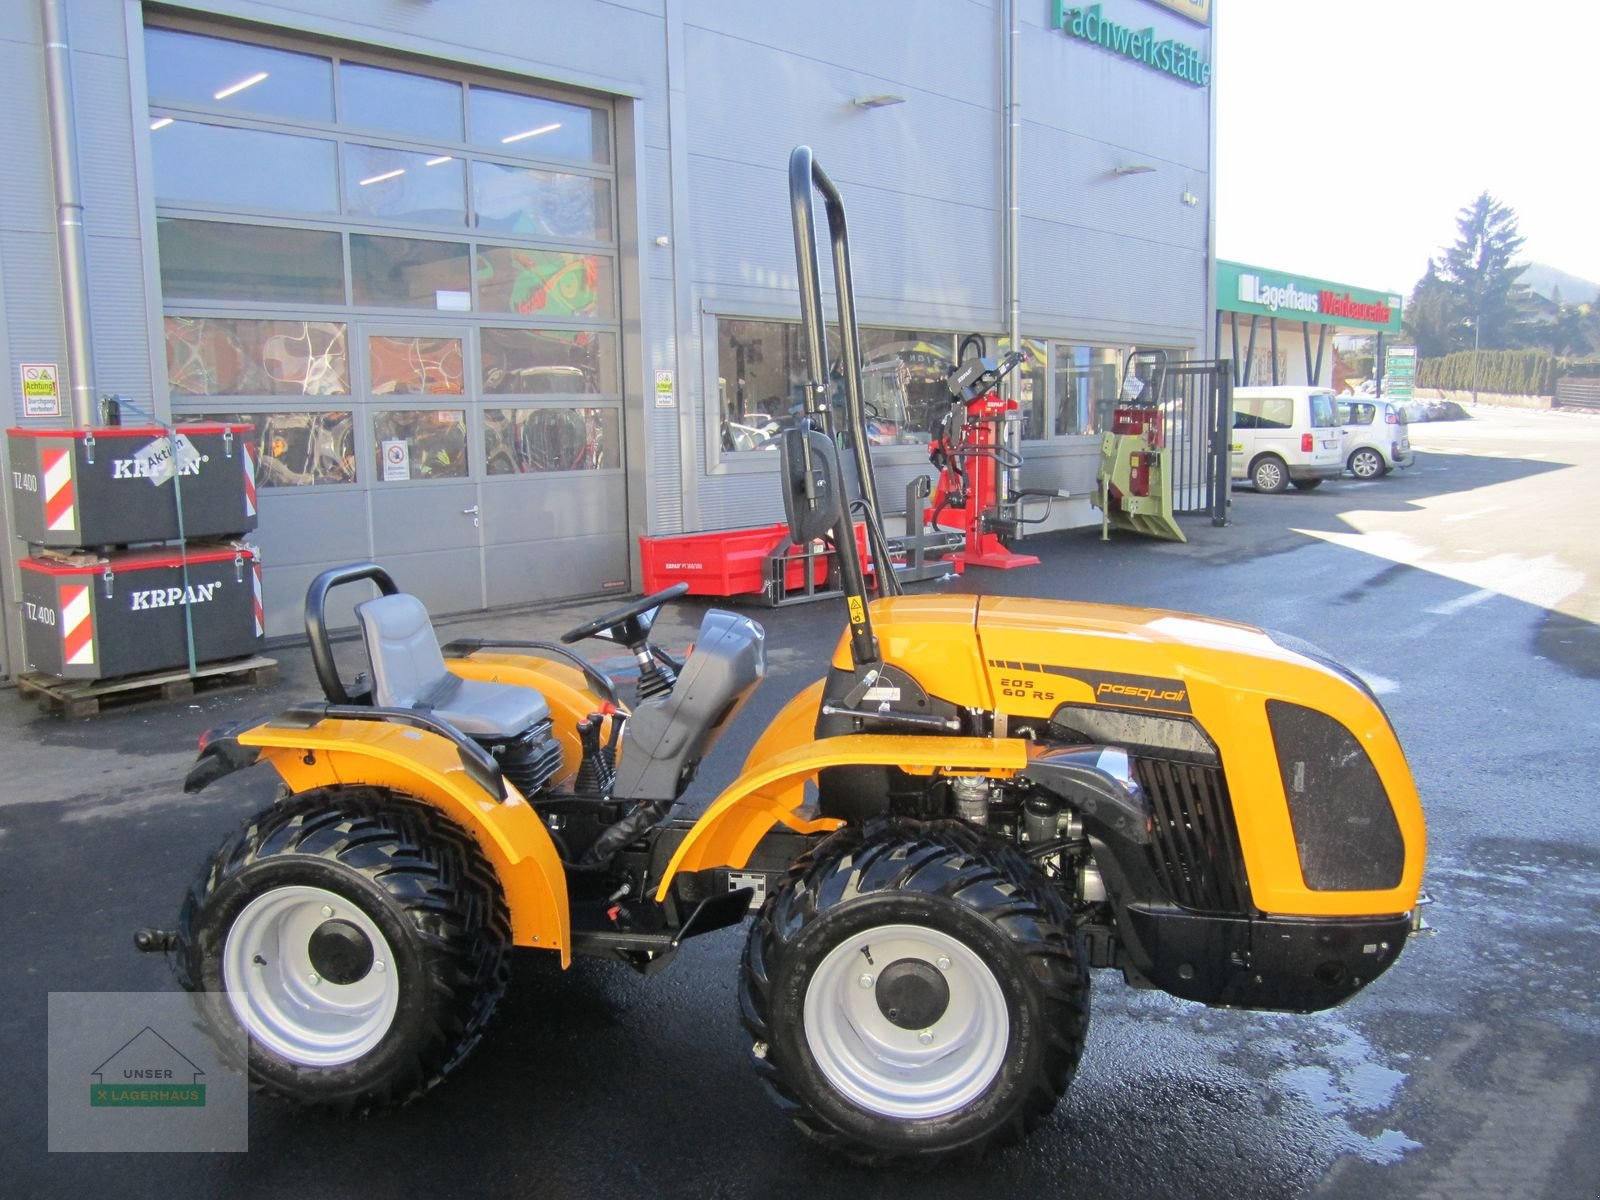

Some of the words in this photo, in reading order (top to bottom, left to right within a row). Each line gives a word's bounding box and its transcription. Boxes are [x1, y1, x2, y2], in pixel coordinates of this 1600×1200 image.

[1255, 275, 1319, 313] Lagerhaus
[147, 438, 184, 470] Aktin
[113, 457, 202, 479] KRN
[12, 471, 23, 489] TZ
[23, 473, 38, 493] 400
[131, 583, 215, 611] KRPAN
[26, 602, 38, 621] TZ
[38, 606, 56, 626] 400
[1000, 678, 1034, 689] EOS
[1002, 688, 1026, 698] 60
[1032, 691, 1055, 700] RS
[1096, 682, 1187, 702] pasquali
